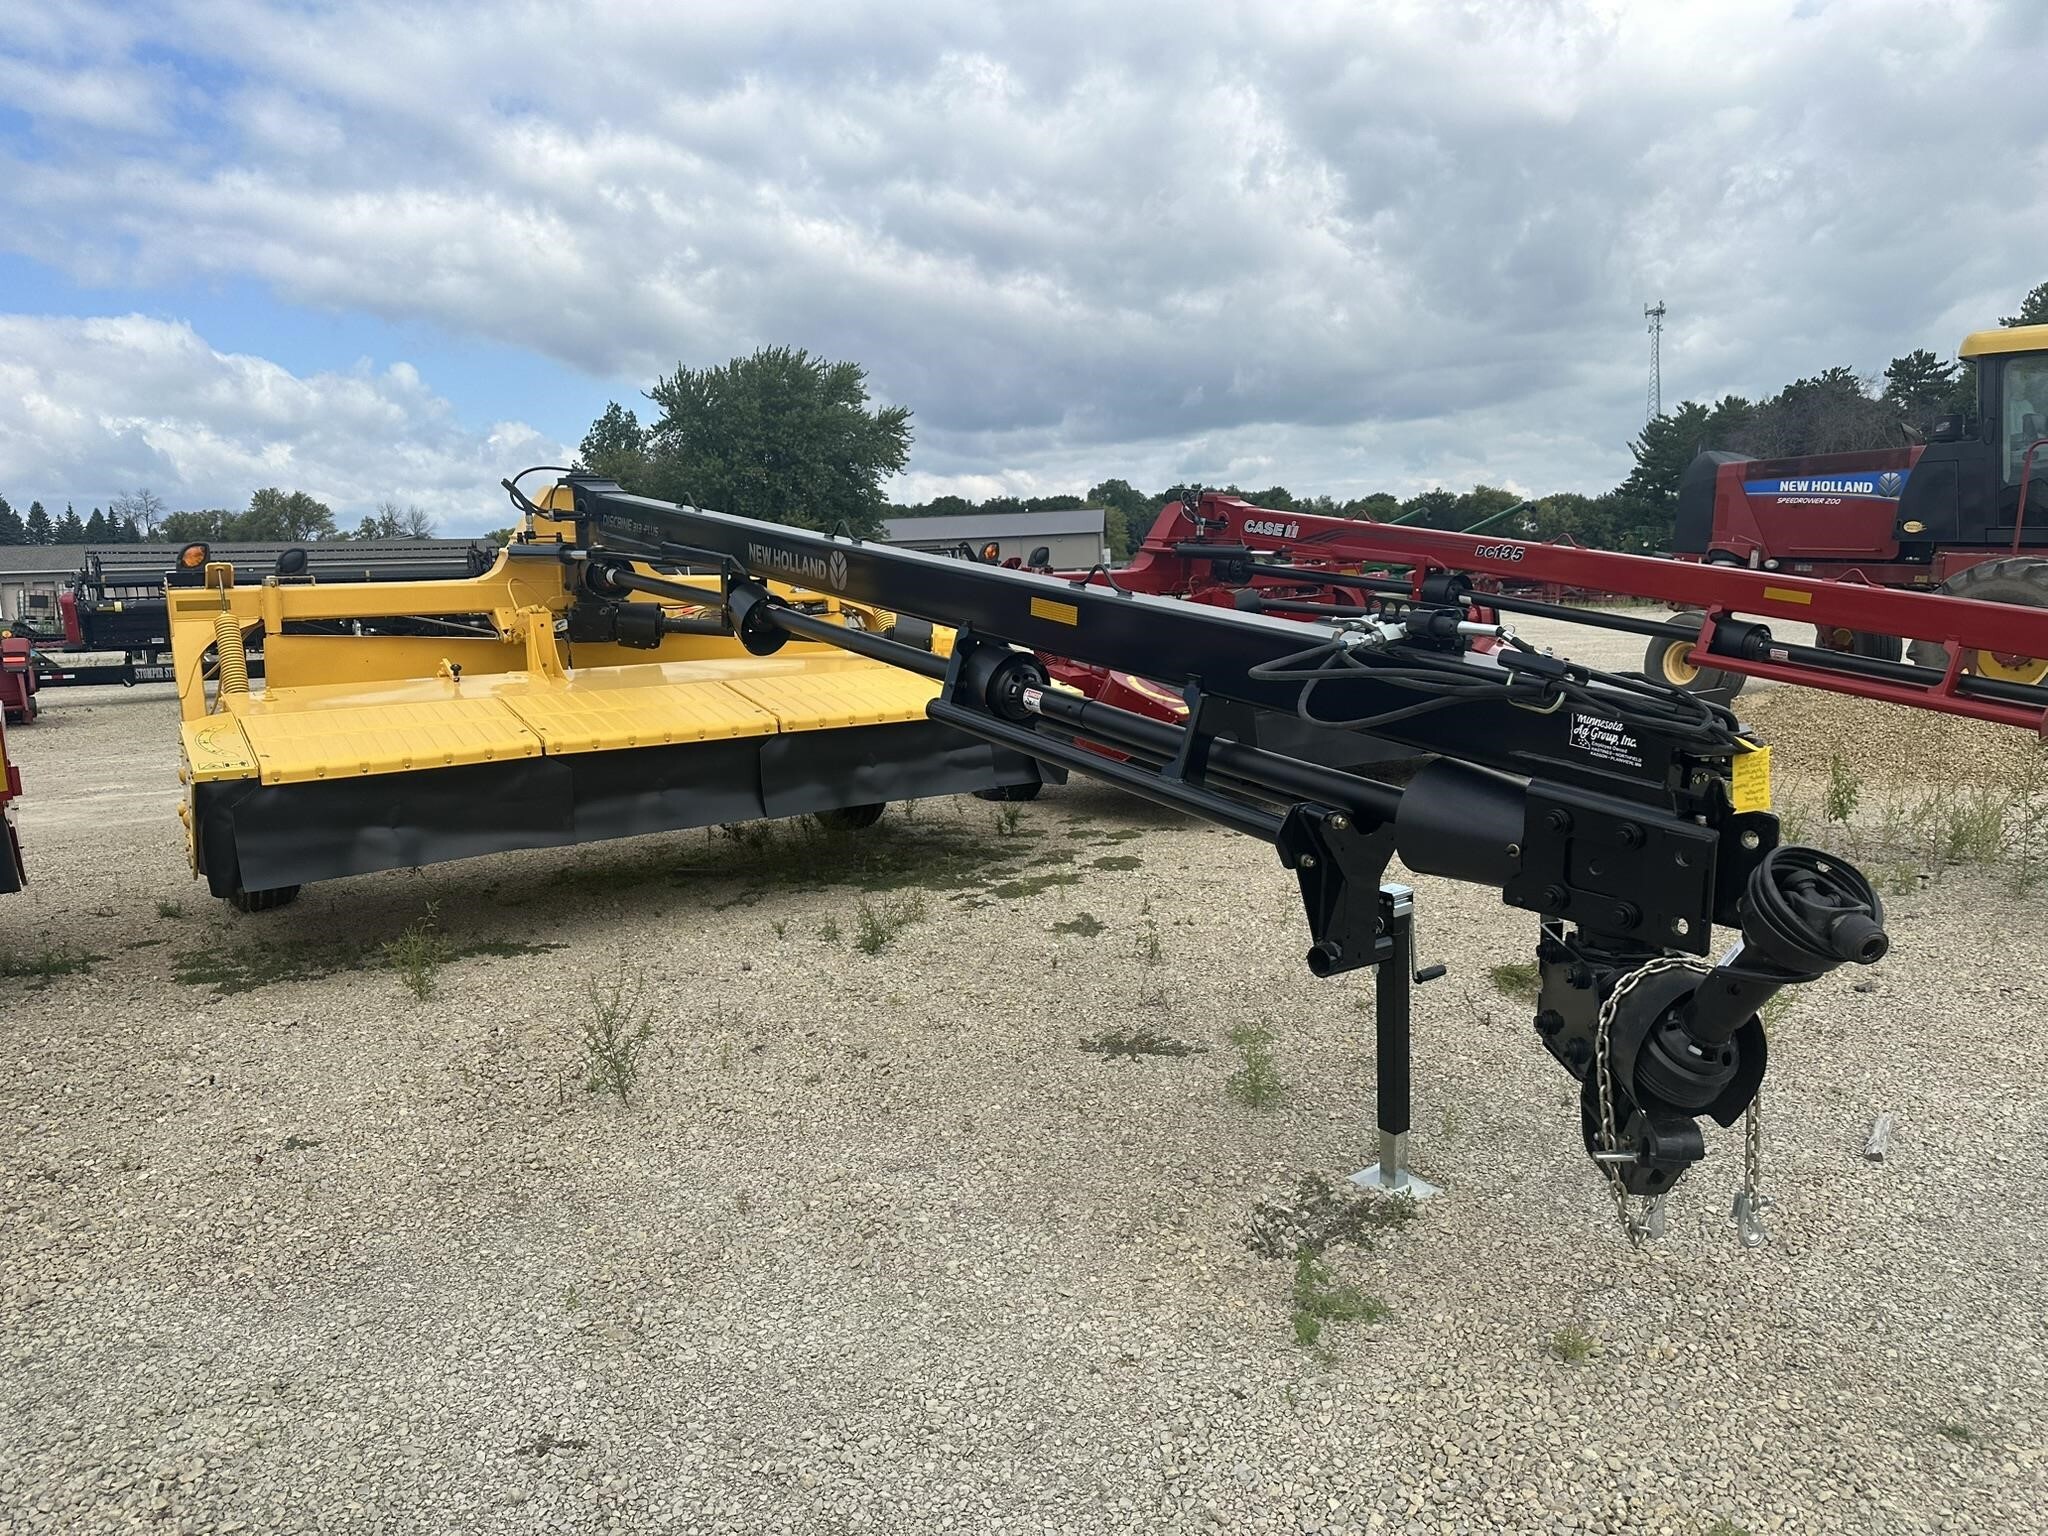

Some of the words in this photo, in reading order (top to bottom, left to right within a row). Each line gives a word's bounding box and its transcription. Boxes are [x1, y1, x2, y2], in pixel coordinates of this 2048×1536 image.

[1780, 480, 1810, 492] NEW
[1811, 481, 1873, 493] HOLLAND
[1243, 519, 1284, 537] CASE
[748, 542, 772, 566] NEW
[773, 548, 827, 580] HOLLAND
[1474, 544, 1526, 562] DC135
[1576, 713, 1624, 732] Minnesota
[1573, 724, 1592, 739] Ag
[1590, 727, 1619, 746] Group,
[1620, 734, 1638, 748] Inc.
